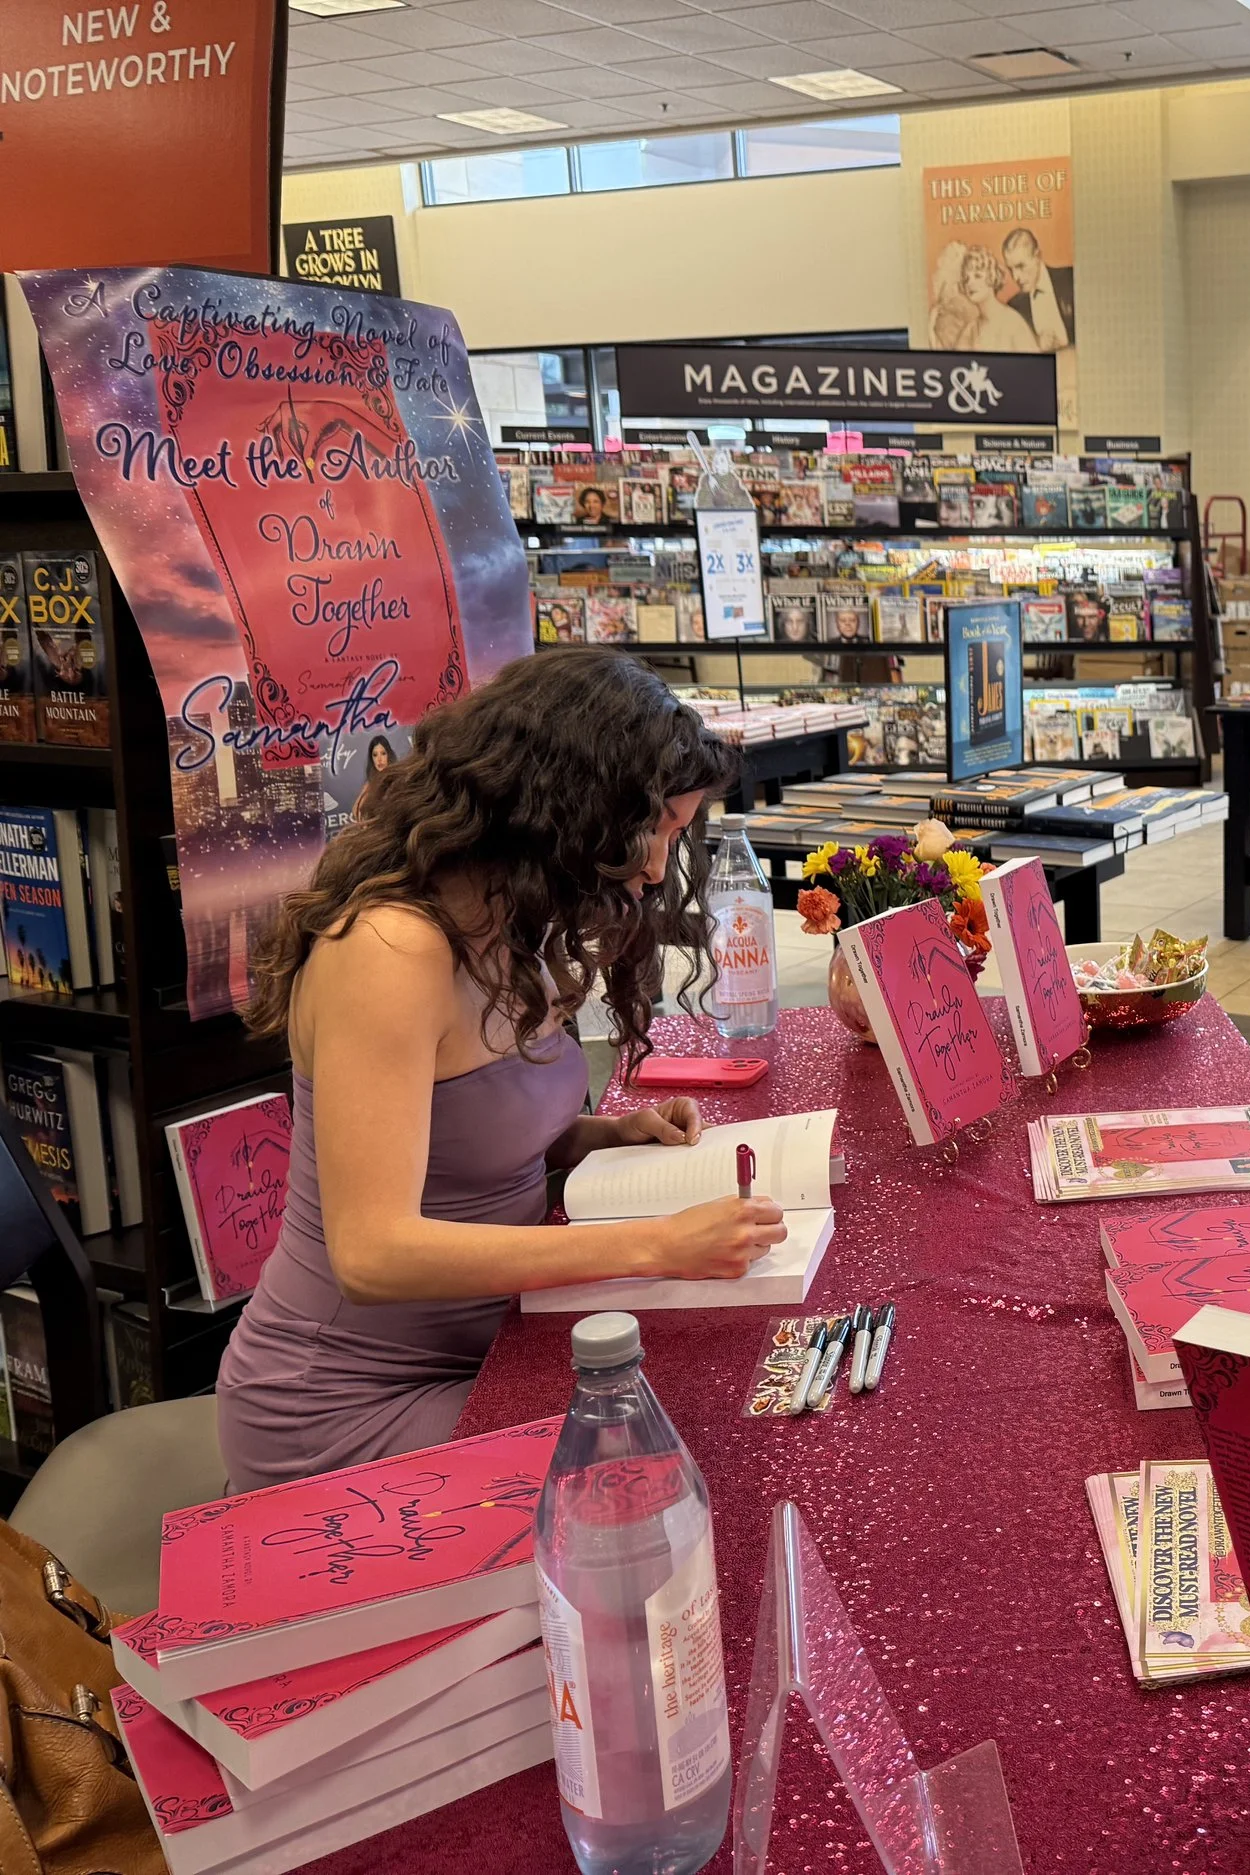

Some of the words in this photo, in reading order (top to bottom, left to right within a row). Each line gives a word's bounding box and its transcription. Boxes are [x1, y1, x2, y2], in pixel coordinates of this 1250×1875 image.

[62, 5, 134, 46] NEW
[150, 0, 171, 33] &
[1, 41, 236, 102] NOTEWORTHY
[929, 176, 972, 201] THIS
[981, 172, 1030, 197] SIDE
[1034, 168, 1067, 192] OF
[940, 196, 1053, 226] PARADISE
[305, 229, 319, 252] A
[319, 227, 365, 252] TREE
[295, 250, 356, 276] GROWS
[360, 248, 379, 271] IN
[63, 282, 110, 318] A
[131, 283, 315, 357] Captivating
[330, 305, 416, 350] Novel
[426, 324, 451, 366] of
[367, 356, 388, 388] &
[393, 357, 450, 394] Fate
[684, 363, 944, 399] MAGAZINES
[515, 429, 545, 441] Current
[547, 430, 575, 442] Events
[983, 437, 1012, 449] Science
[1023, 438, 1047, 449] Nature
[95, 422, 237, 488] Meet
[246, 435, 301, 486] the
[320, 431, 459, 489] Author
[319, 488, 334, 518] of
[258, 513, 402, 564] Drawn
[34, 567, 79, 592] C.J.
[707, 552, 725, 574] 2X
[736, 552, 754, 574] 3X
[29, 594, 95, 624] BOX
[286, 573, 412, 657] Together
[46, 706, 97, 722] MOUNTAIN
[51, 690, 86, 705] BATTLE
[176, 660, 399, 776] Samantha
[19, 885, 61, 908] SEASON
[989, 892, 997, 909] Drawn
[992, 908, 1001, 929] Together
[714, 947, 769, 969] PANNA
[726, 936, 757, 948] ACQUA
[851, 944, 860, 964] Drawn
[858, 962, 869, 985] Together
[907, 984, 963, 1035] Drawn
[1015, 1005, 1025, 1029] Samantha
[1020, 1028, 1028, 1047] Zamora
[918, 1006, 978, 1081] Together
[896, 1066, 909, 1093] Samantha
[905, 1092, 915, 1112] Zamora
[11, 1102, 65, 1131] HURWITZ
[215, 1169, 284, 1214] Drawn
[1160, 1389, 1182, 1398] Drawn
[1155, 1485, 1173, 1514] NEW
[1179, 1487, 1198, 1532] NOVEL
[382, 1472, 467, 1562] Drawn
[1154, 1515, 1173, 1546] THE
[221, 1524, 235, 1570] SAMANTHA
[261, 1487, 406, 1585] Together
[222, 1573, 236, 1608] ZAMORA
[1153, 1547, 1173, 1622] DISCOVER
[682, 1599, 697, 1621] of
[660, 1621, 678, 1690] heritage
[664, 1691, 679, 1718] the
